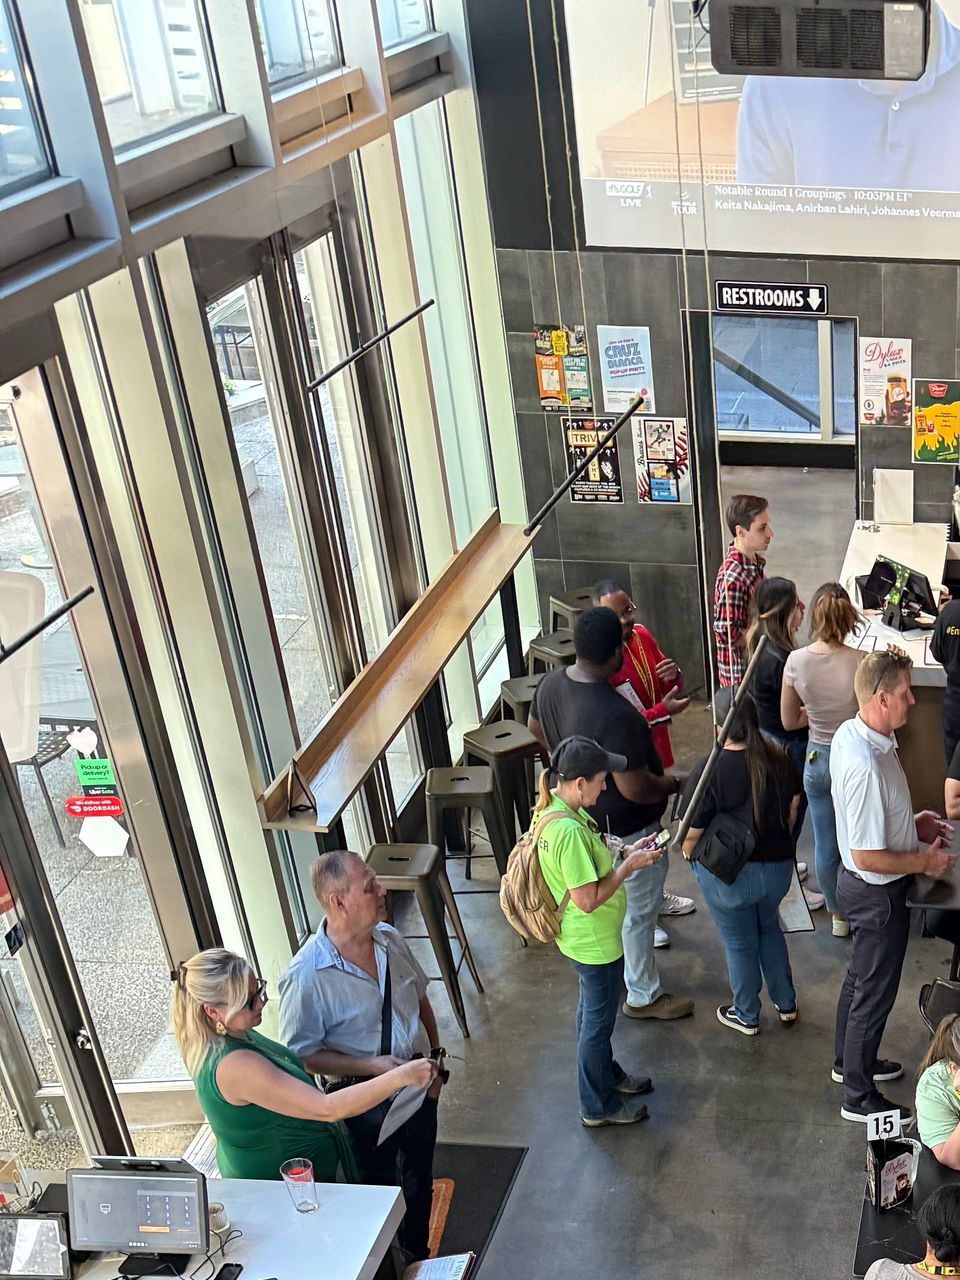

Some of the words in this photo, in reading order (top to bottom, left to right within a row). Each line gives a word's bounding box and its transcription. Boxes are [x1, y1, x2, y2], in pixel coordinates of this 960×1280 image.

[619, 184, 641, 194] GOLF
[715, 185, 753, 195] Notable
[755, 187, 786, 197] Round
[795, 188, 847, 201] Groupings
[620, 198, 642, 208] LIVE
[715, 200, 742, 210] Keita
[743, 201, 794, 213] Nakajima,
[796, 203, 836, 213] Anirban
[838, 203, 870, 216] Lahiri,
[871, 206, 920, 217] Johannes
[672, 206, 697, 215] TOUR
[722, 287, 805, 308] RESTROOMS
[605, 343, 641, 359] CRUZ
[864, 341, 904, 369] Dylux
[608, 356, 644, 369] BLANCA
[574, 433, 607, 443] TRIV
[80, 764, 101, 773] Pickup
[82, 769, 110, 778] delivery?
[83, 804, 120, 812] DOORDASH
[873, 1114, 894, 1136] 15
